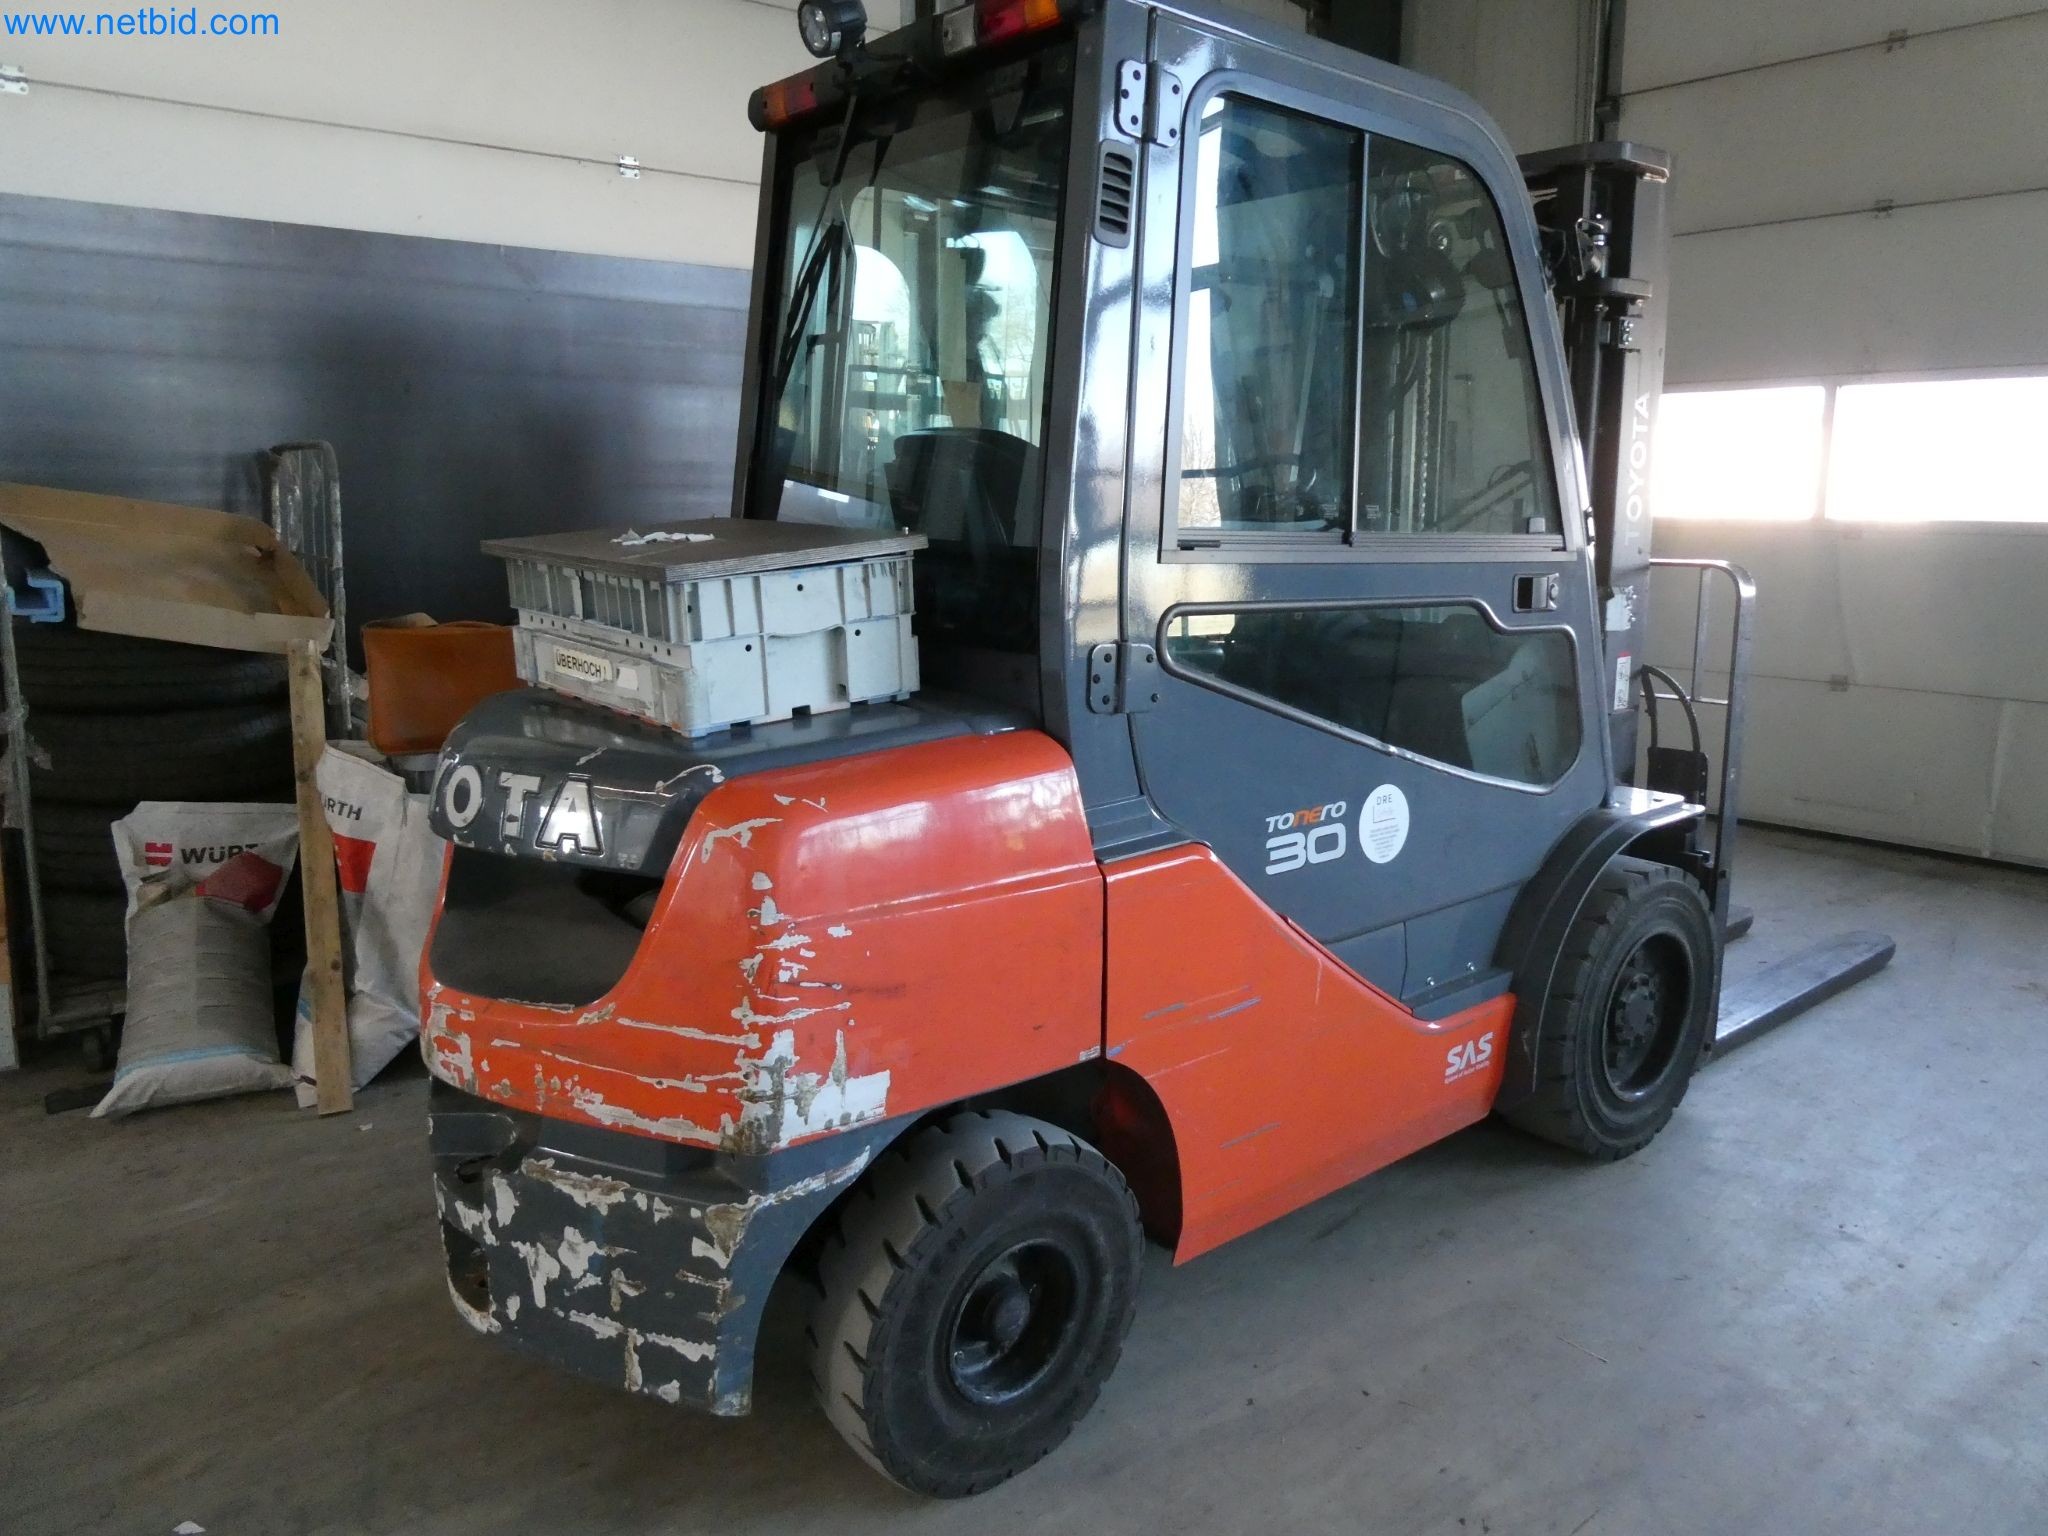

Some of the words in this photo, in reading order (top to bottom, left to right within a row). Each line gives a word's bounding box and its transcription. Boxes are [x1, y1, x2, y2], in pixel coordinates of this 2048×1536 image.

[1624, 391, 1650, 546] TOYOTA
[325, 794, 363, 821] RTH
[181, 843, 265, 864] WÜR
[1265, 823, 1347, 875] 30
[1445, 1031, 1493, 1076] SAS
